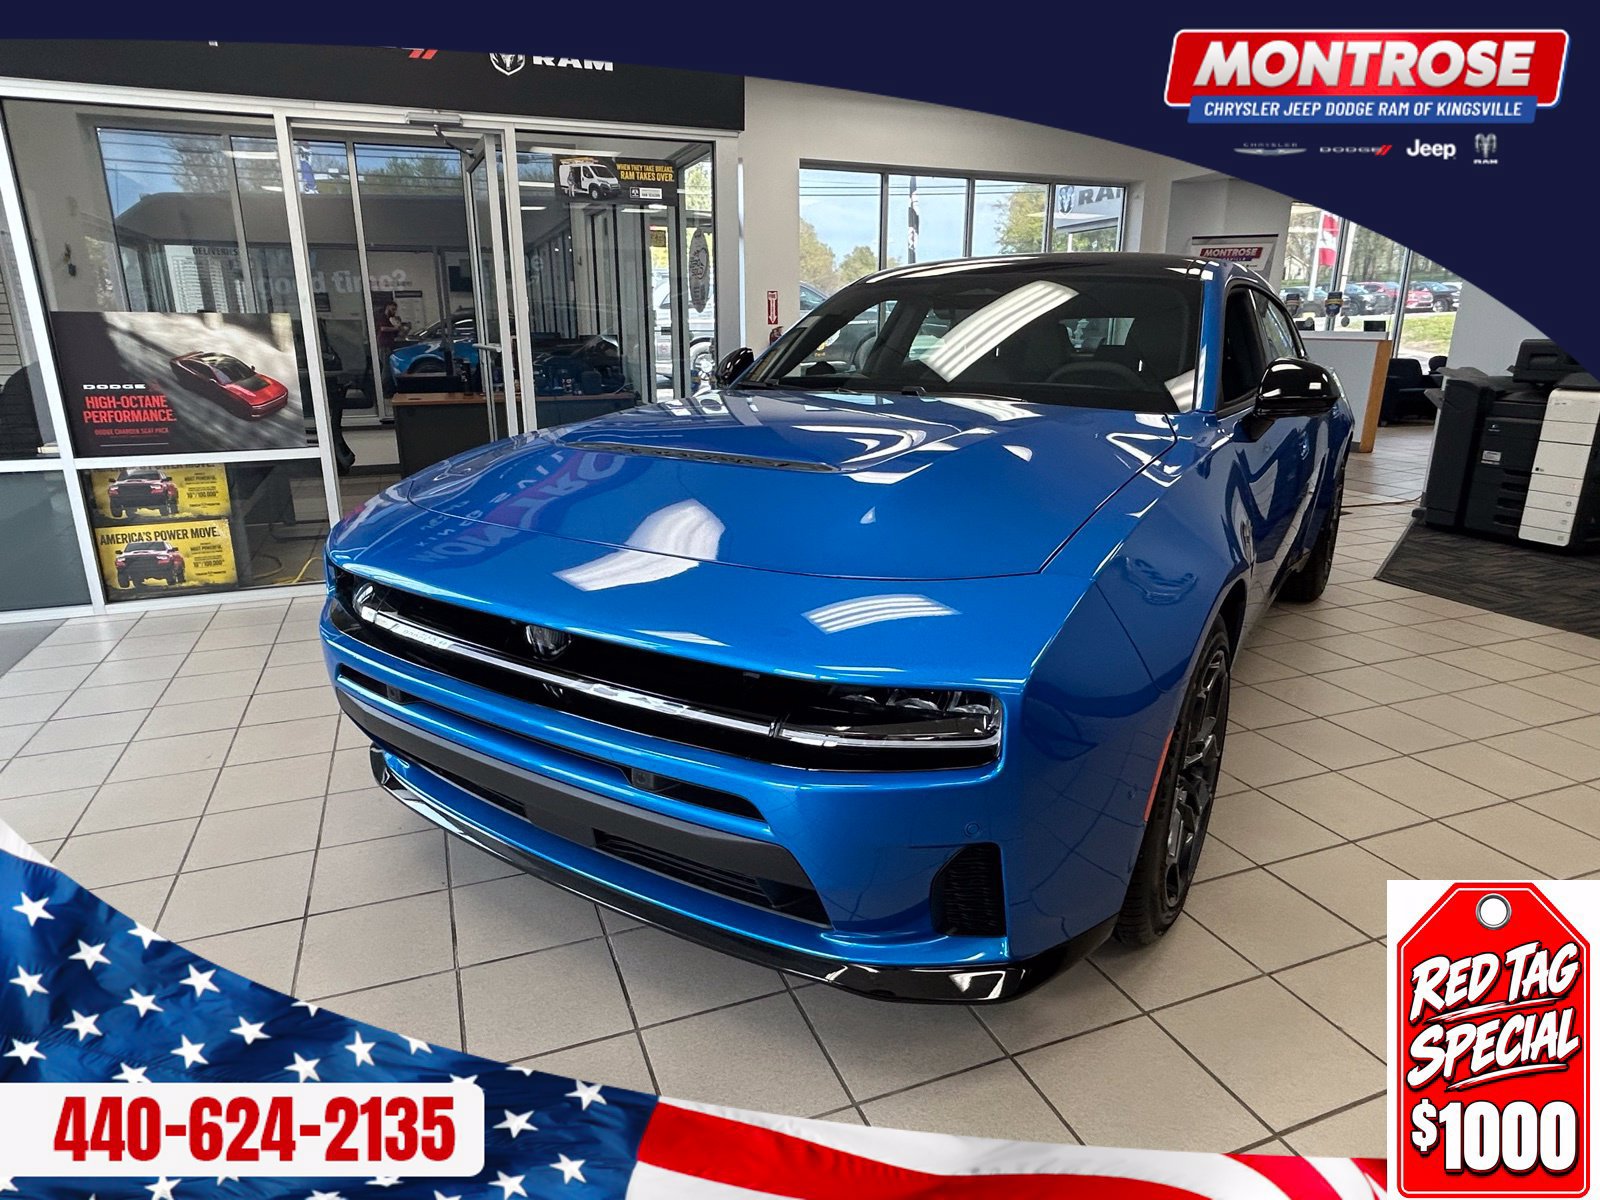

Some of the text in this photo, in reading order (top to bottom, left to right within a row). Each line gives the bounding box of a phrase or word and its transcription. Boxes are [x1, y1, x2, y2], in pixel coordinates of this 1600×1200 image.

[620, 171, 675, 182] RAM TAKES OVER.
[1204, 248, 1258, 257] MONTROSE
[84, 394, 169, 409] HIGH-OCTANE
[82, 408, 177, 423] PERFORMANCE.
[100, 526, 220, 546] AMERICA'S POWER MOVE.
